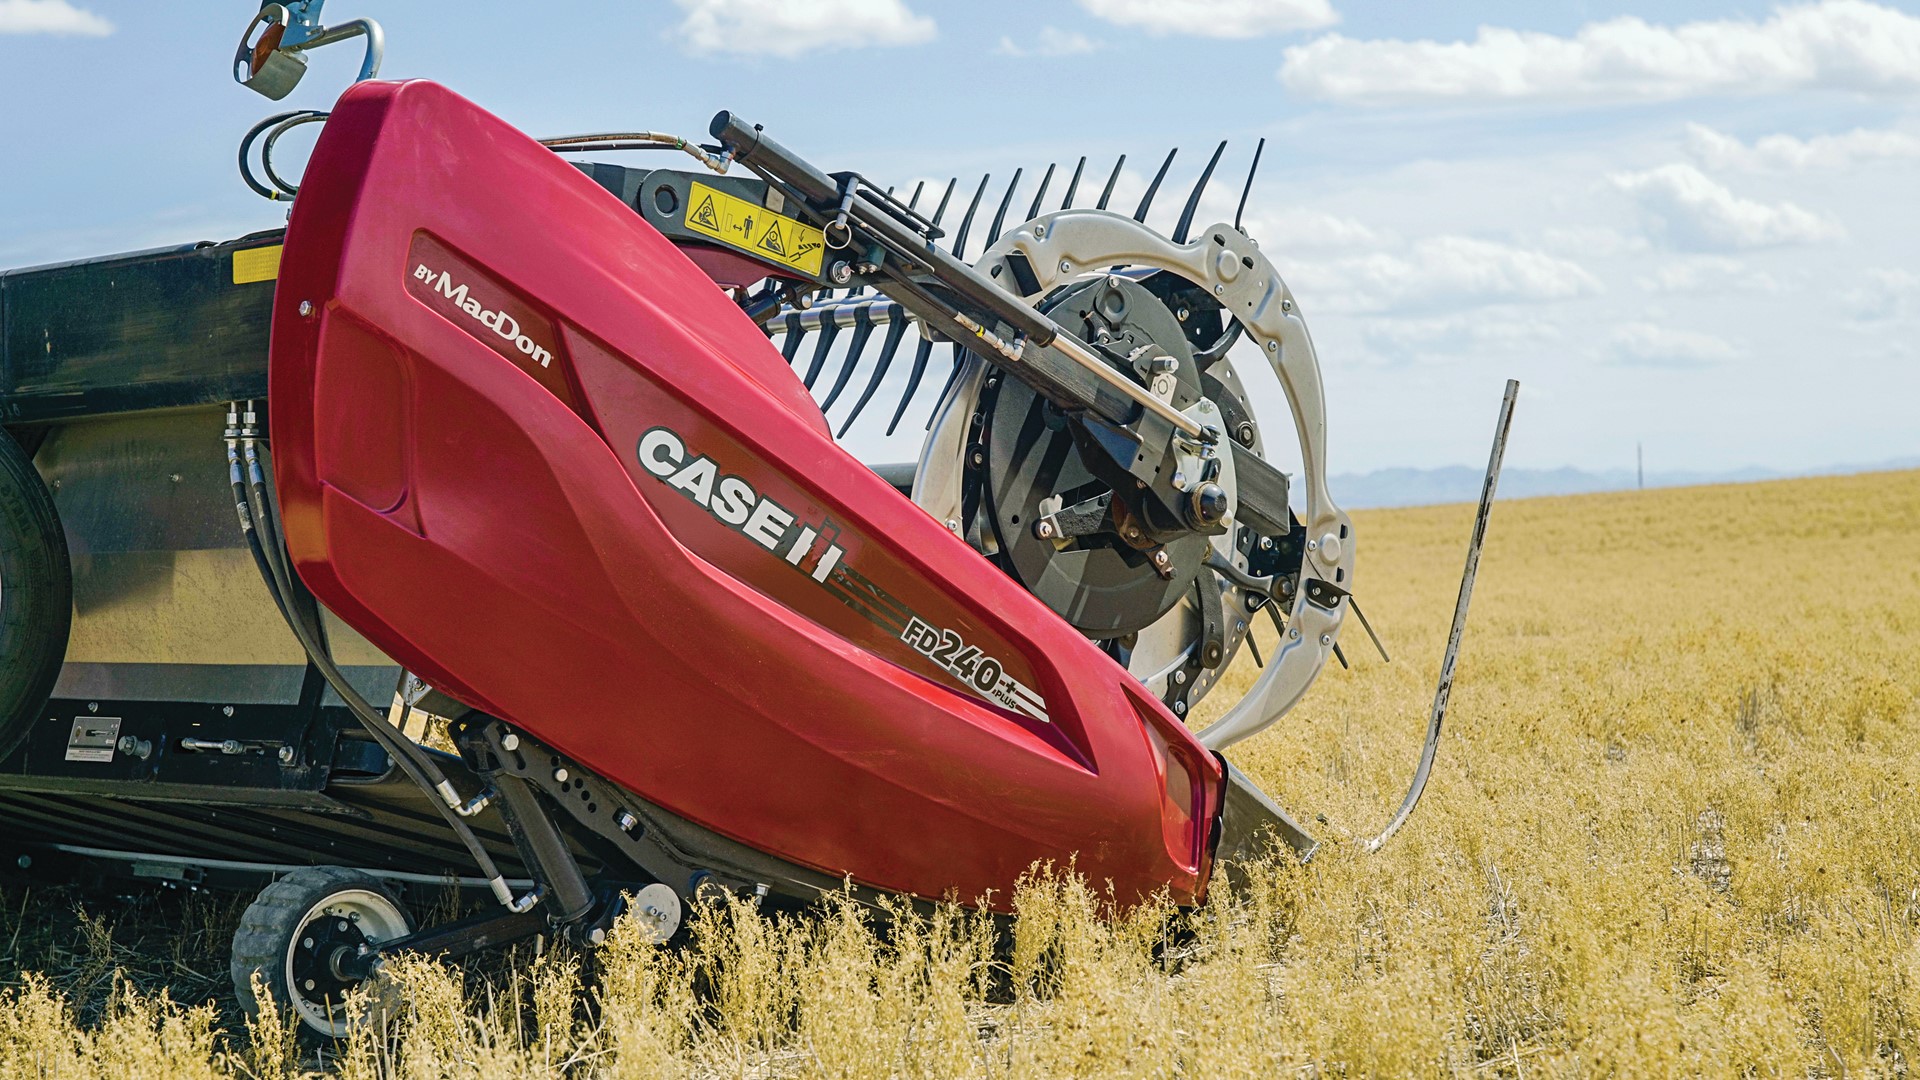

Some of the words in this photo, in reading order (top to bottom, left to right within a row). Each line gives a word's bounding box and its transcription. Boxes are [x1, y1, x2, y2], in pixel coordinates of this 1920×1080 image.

[413, 263, 438, 285] BY
[434, 270, 552, 369] MacDon
[637, 428, 796, 552] CASE
[900, 616, 1003, 695] FD240
[994, 689, 1018, 710] PLUS
